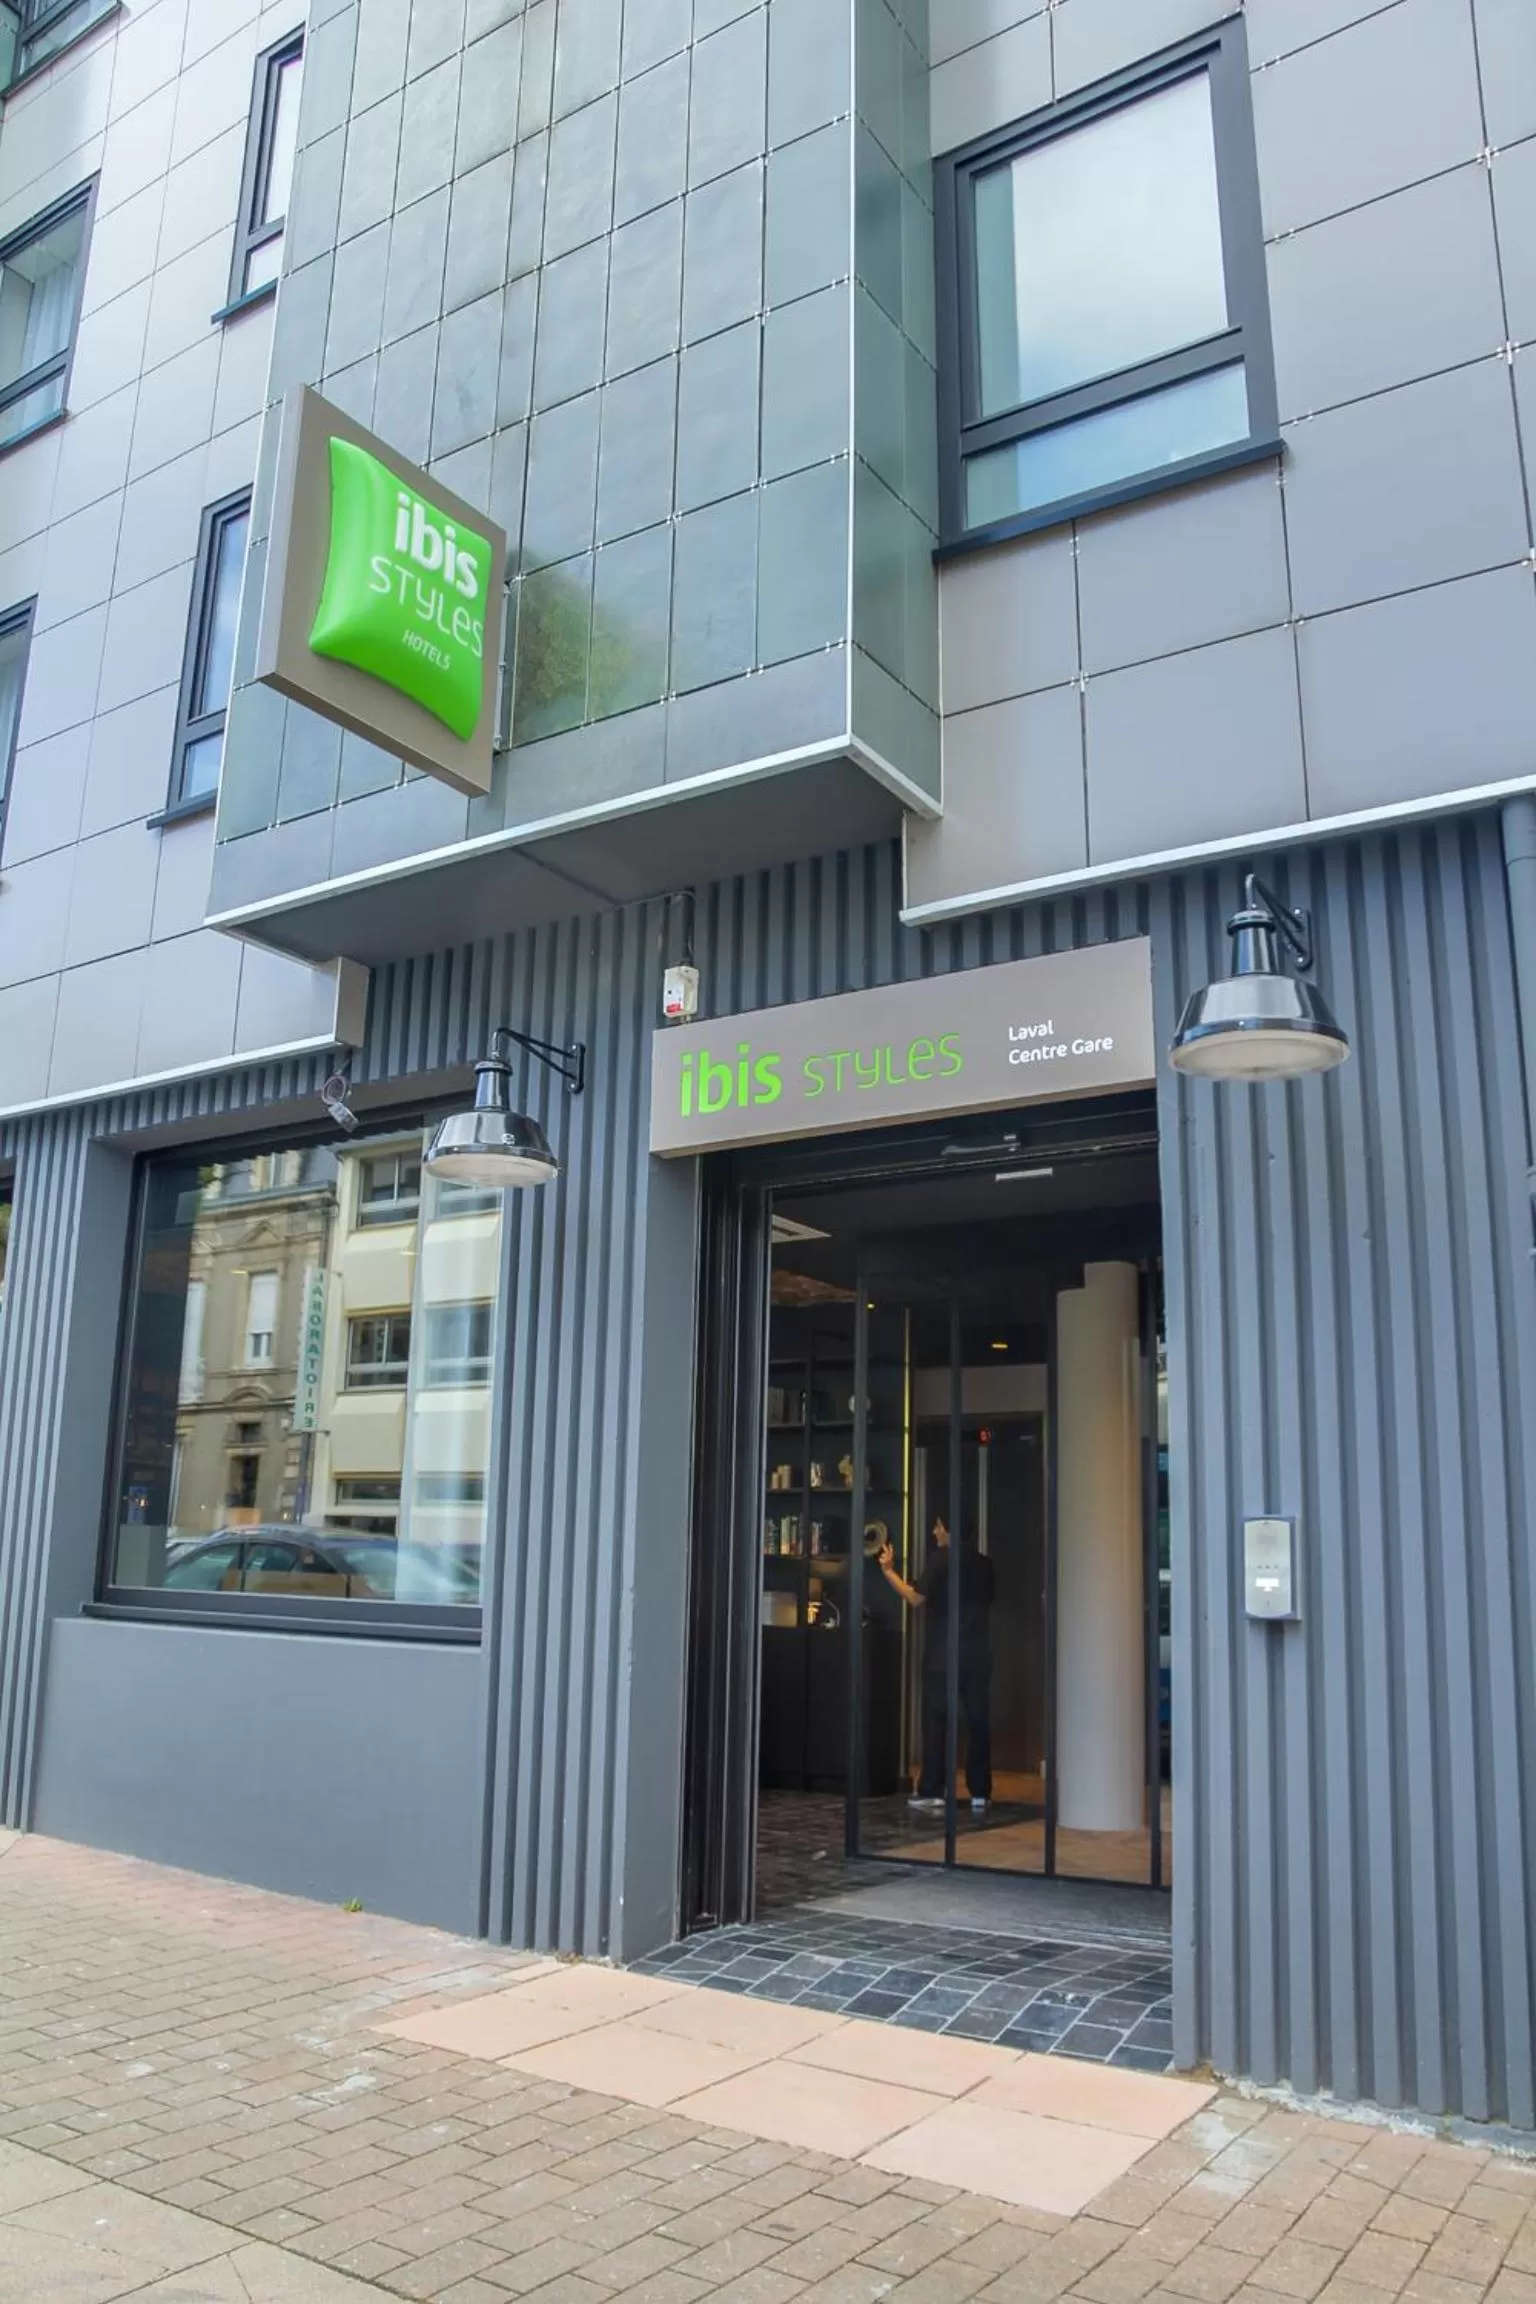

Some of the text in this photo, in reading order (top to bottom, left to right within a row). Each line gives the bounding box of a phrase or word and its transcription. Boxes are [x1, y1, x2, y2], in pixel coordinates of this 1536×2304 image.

[394, 491, 479, 599] ibis
[402, 630, 451, 670] HOTELS
[1008, 1018, 1055, 1041] Laval
[1008, 1035, 1114, 1066] Centre Gare
[680, 1043, 781, 1118] ibis
